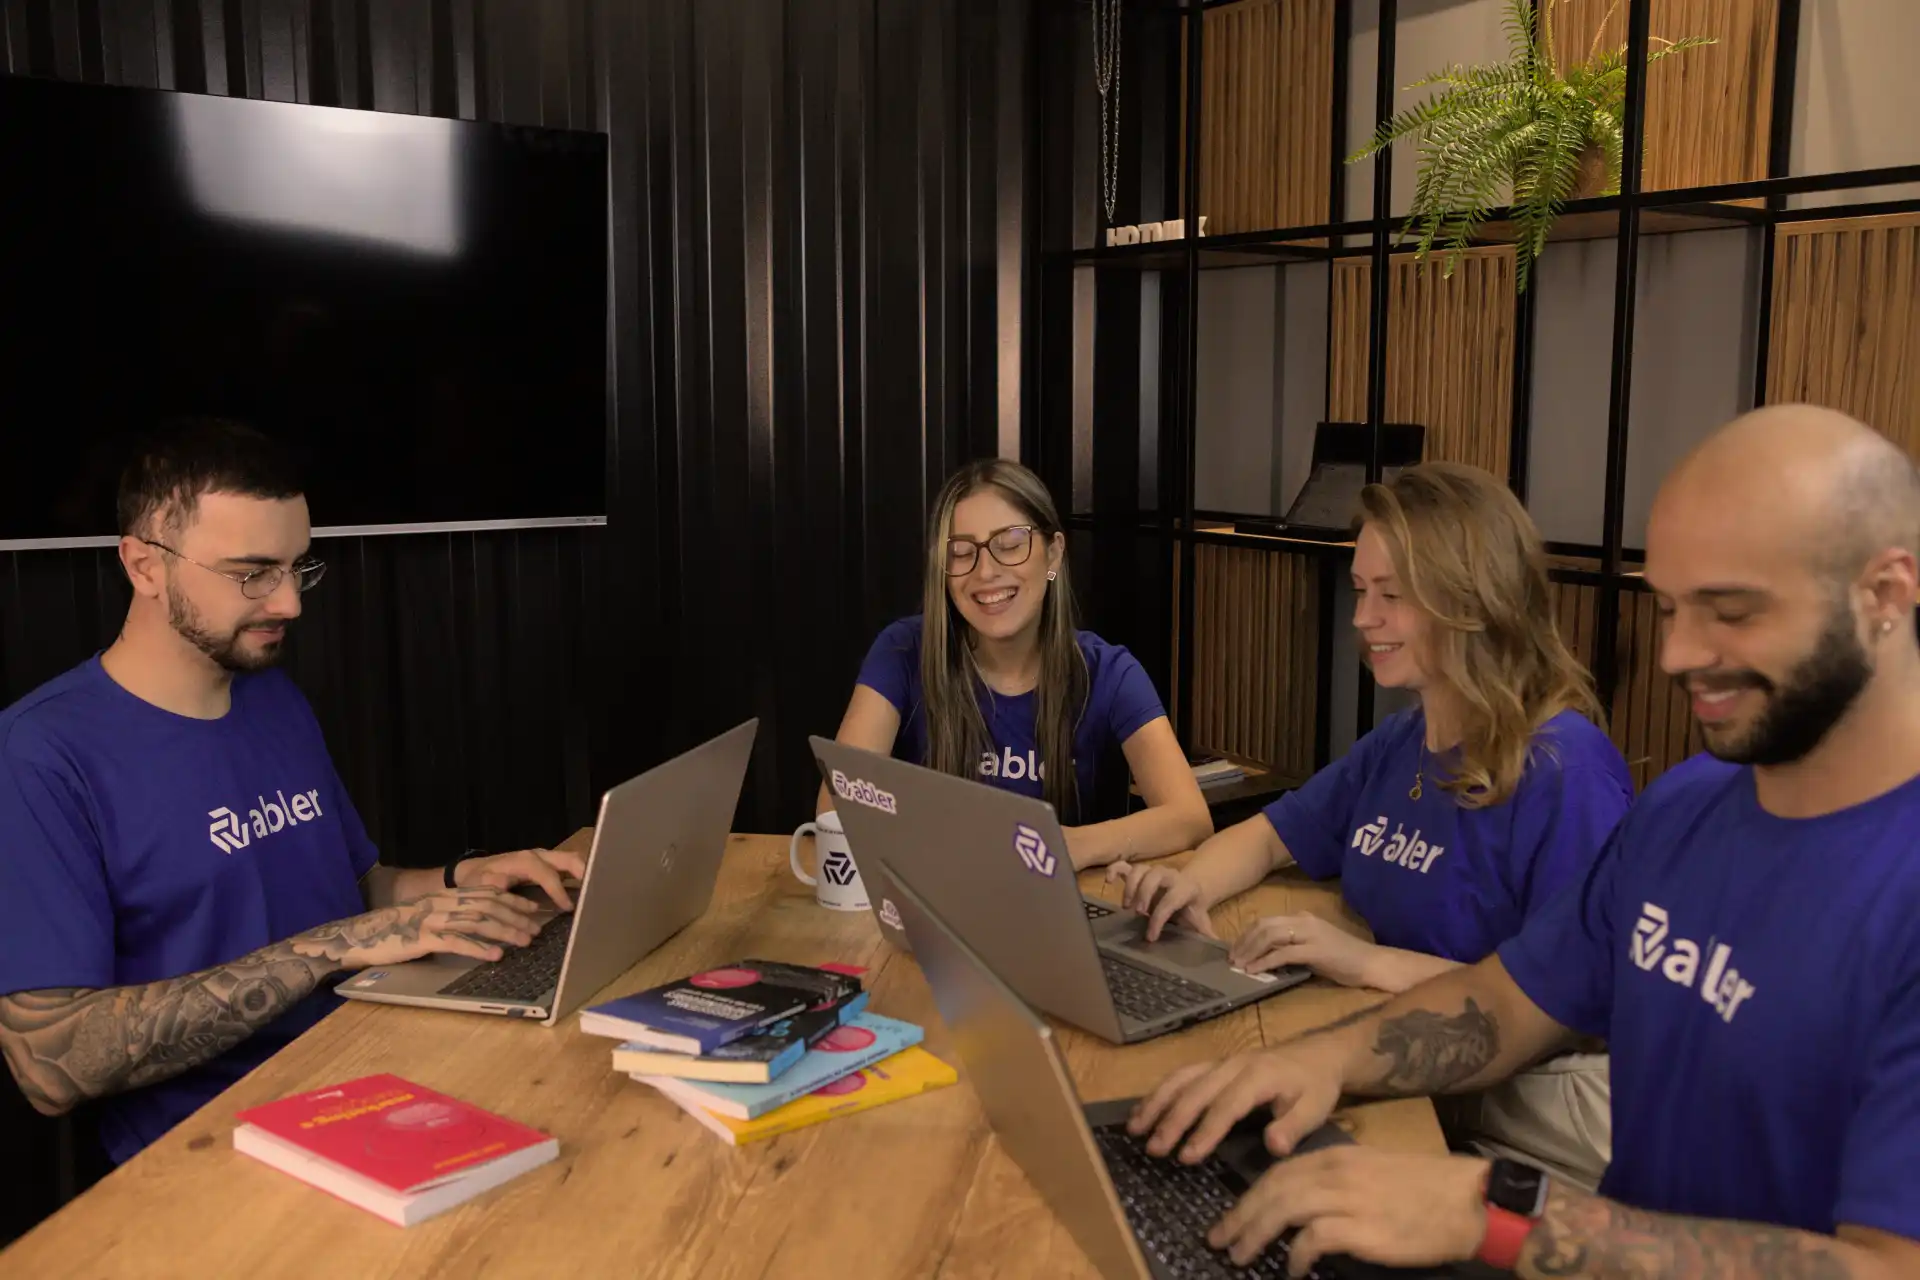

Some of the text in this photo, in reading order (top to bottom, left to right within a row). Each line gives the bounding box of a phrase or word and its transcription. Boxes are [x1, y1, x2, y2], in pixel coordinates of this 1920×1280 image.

[979, 746, 1046, 782] abl
[249, 789, 323, 839] abler
[854, 782, 894, 811] abler
[1382, 822, 1444, 874] aler
[1662, 934, 1756, 1023] aler
